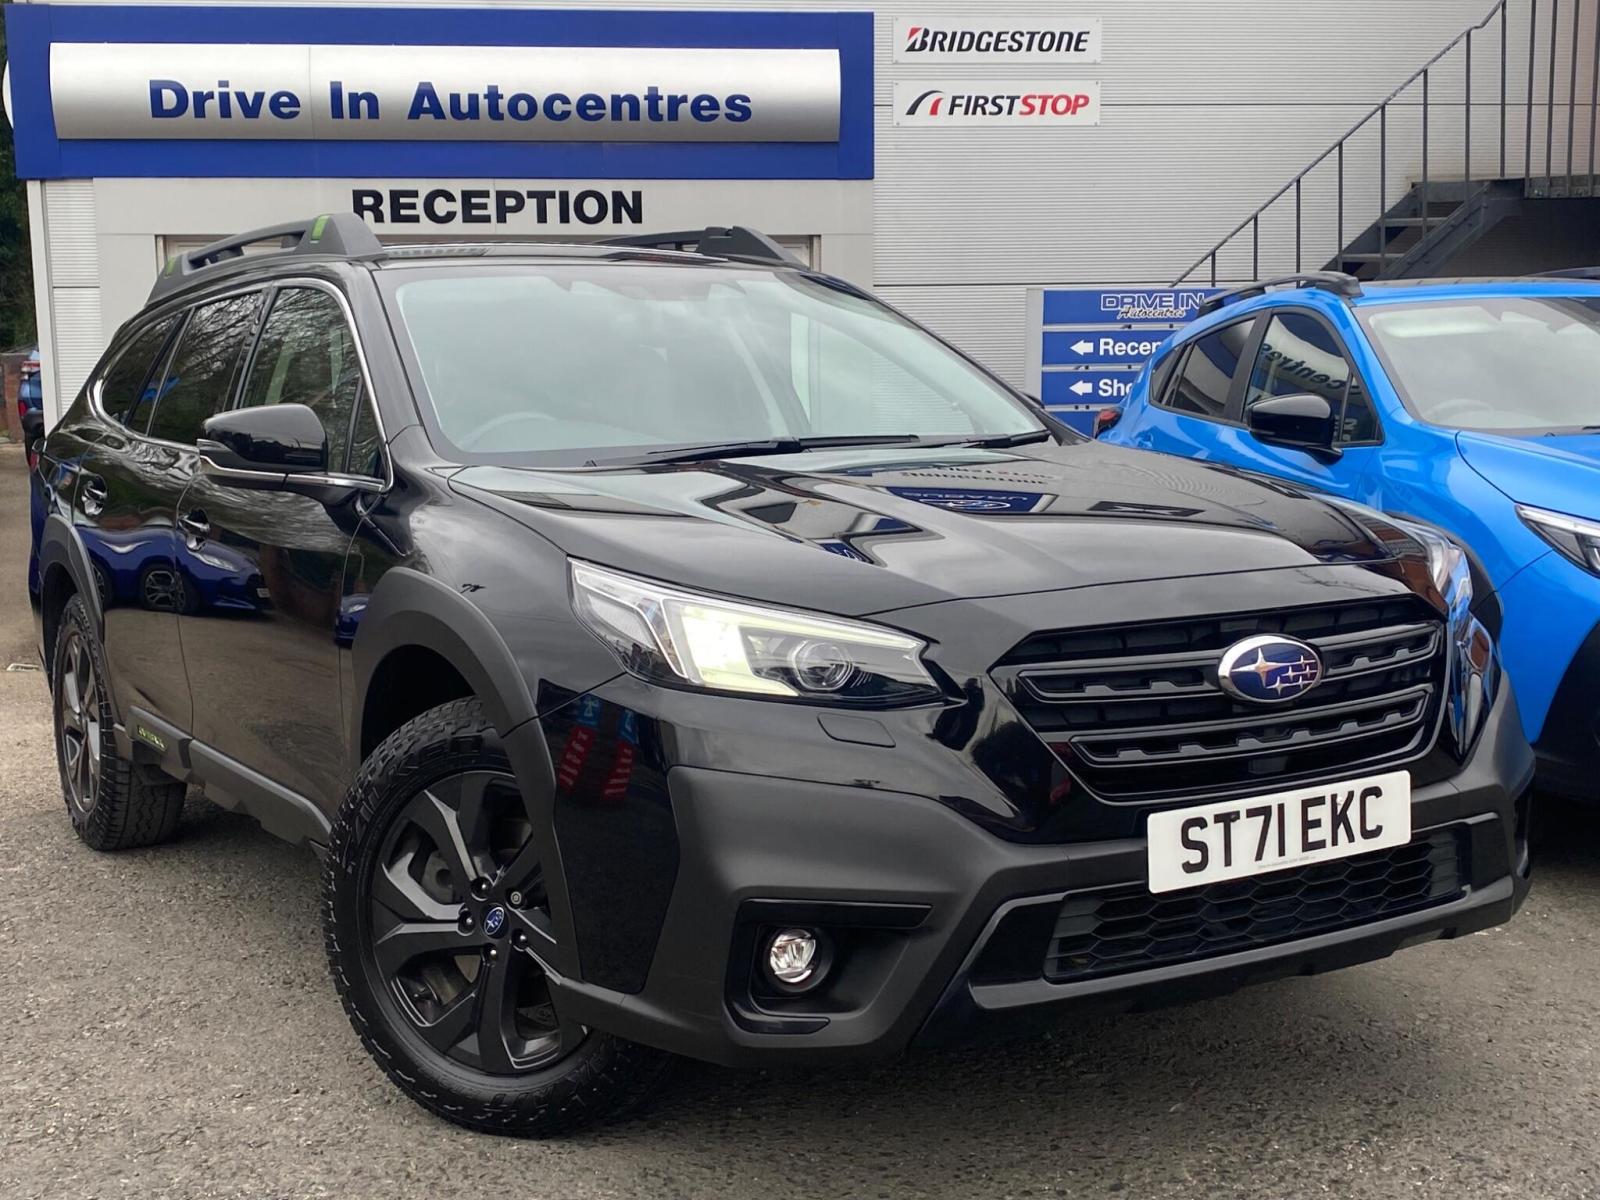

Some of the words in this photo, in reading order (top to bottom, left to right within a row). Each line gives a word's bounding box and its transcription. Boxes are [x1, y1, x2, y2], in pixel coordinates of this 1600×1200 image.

[905, 27, 1090, 53] BRIDGESTONE
[149, 80, 301, 120] Drive
[329, 81, 380, 120] In
[408, 81, 753, 123] Autocentres
[948, 94, 1090, 116] FIRSTSTOP
[351, 188, 643, 225] RECEPTION
[1101, 293, 1174, 311] DRIVE
[1178, 293, 1204, 310] IN
[1116, 305, 1186, 319] Autocentres
[1181, 803, 1286, 874] ST71
[1301, 785, 1383, 853] EKC
